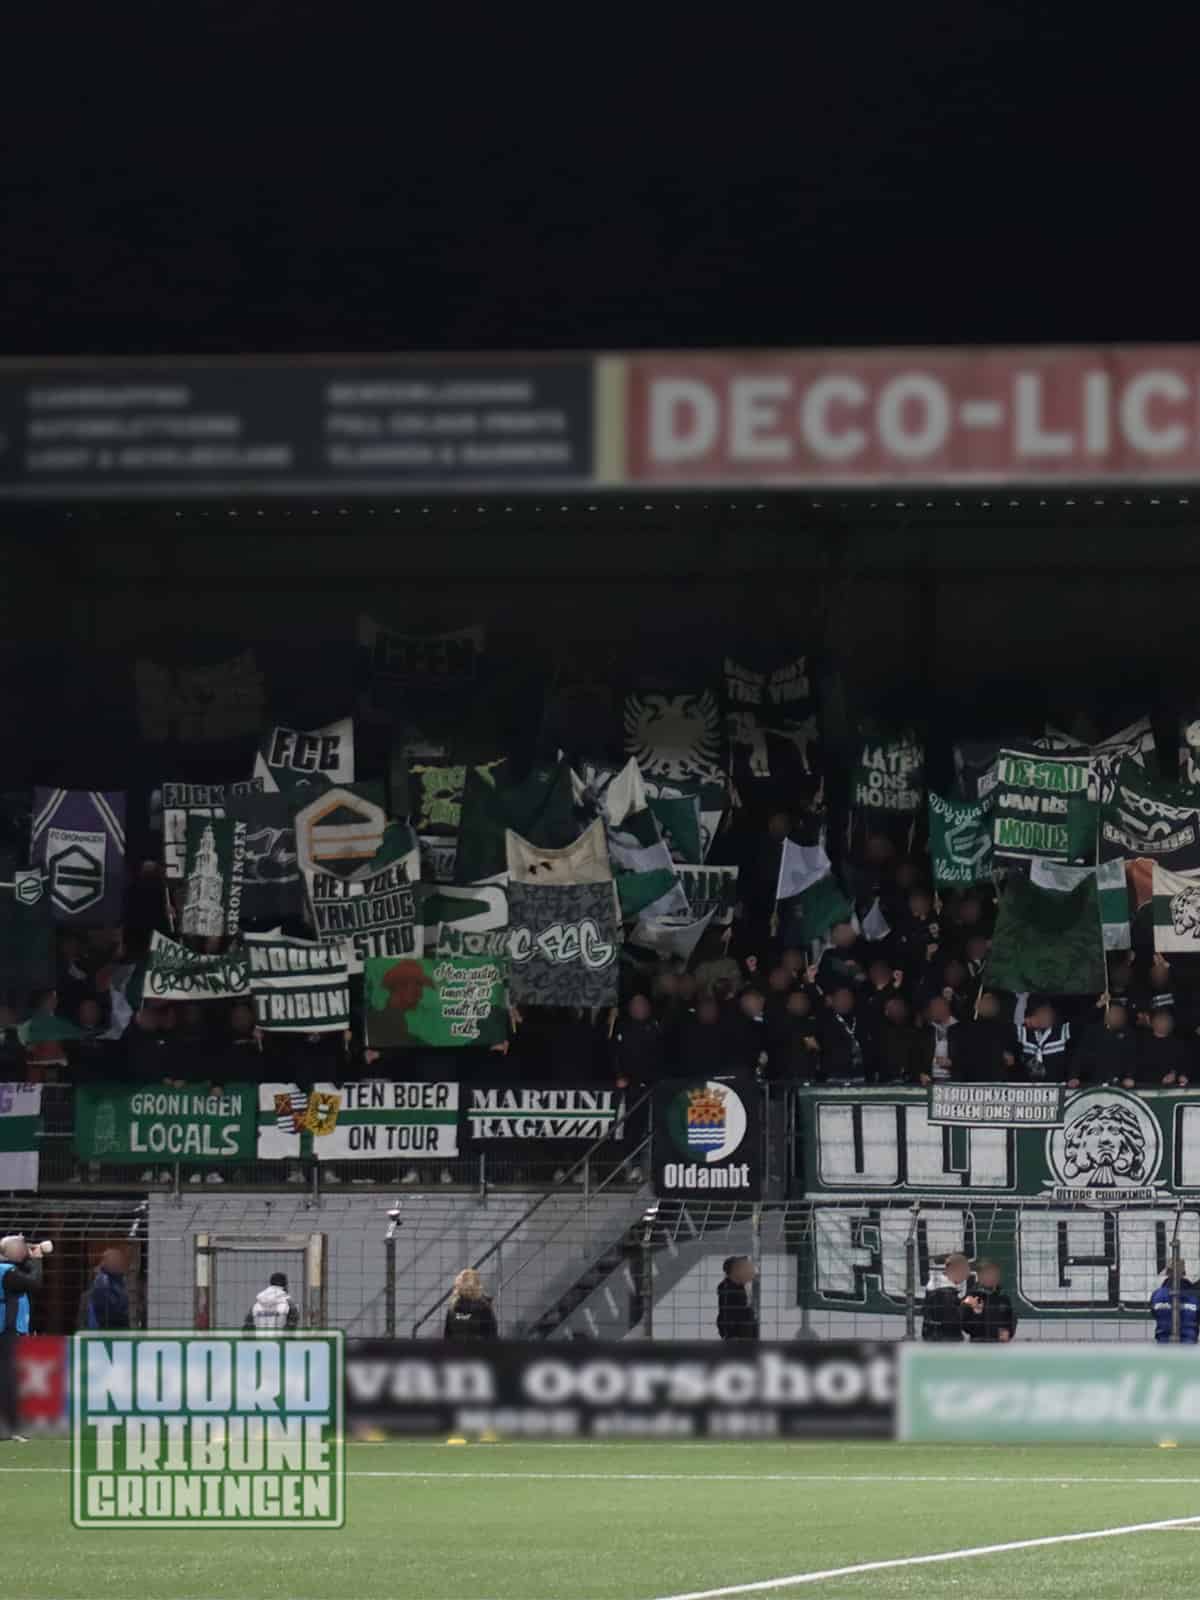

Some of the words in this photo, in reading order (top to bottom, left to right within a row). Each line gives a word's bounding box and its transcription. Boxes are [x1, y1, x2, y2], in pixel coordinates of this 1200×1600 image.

[270, 728, 340, 770] FCG
[862, 743, 924, 774] LATEN
[869, 770, 908, 789] ONS
[855, 783, 921, 808] HOREN
[313, 873, 350, 898] HET
[363, 861, 411, 895] VOLK
[131, 1092, 242, 1116] GRONINGEN
[344, 1083, 386, 1109] TEN
[394, 1083, 450, 1108] BOER
[471, 1088, 615, 1110] MARTINI
[130, 1121, 241, 1156] LOCALS
[349, 1126, 376, 1151] ON
[385, 1126, 439, 1151] TOUR
[663, 1163, 751, 1189] Oldambt
[346, 1359, 496, 1402] van
[521, 1351, 896, 1403] oorschot
